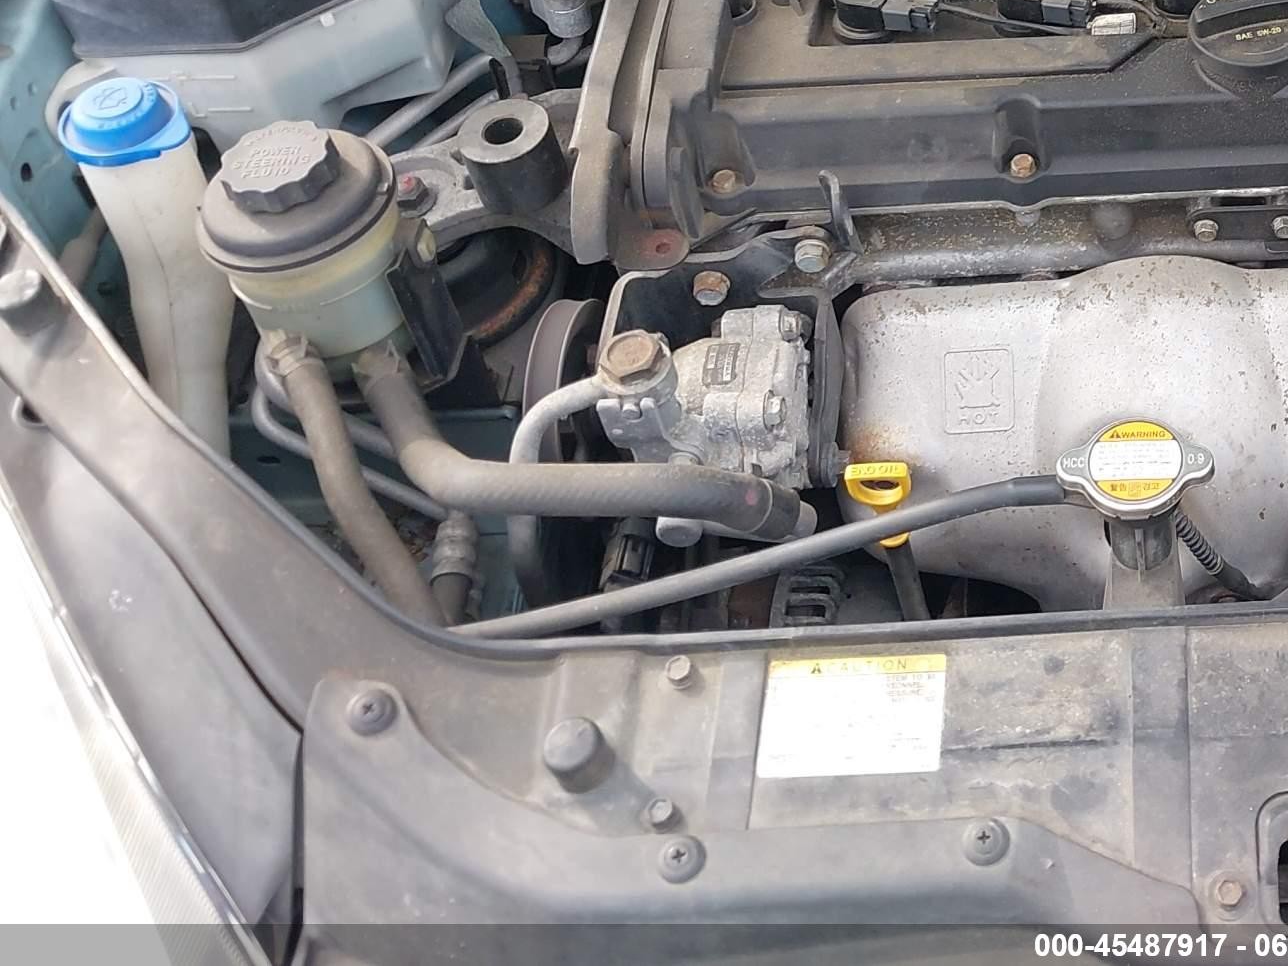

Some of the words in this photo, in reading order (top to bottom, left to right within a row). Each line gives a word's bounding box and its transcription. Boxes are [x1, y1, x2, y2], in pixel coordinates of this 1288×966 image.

[1235, 31, 1253, 41] SAE
[250, 145, 302, 157] POWER
[233, 154, 312, 170] STEERING
[241, 167, 290, 179] FLUID
[958, 412, 1001, 426] HOT
[1120, 430, 1166, 439] WARNING
[1062, 457, 1085, 468] HCC
[1187, 454, 1205, 465] 0.9
